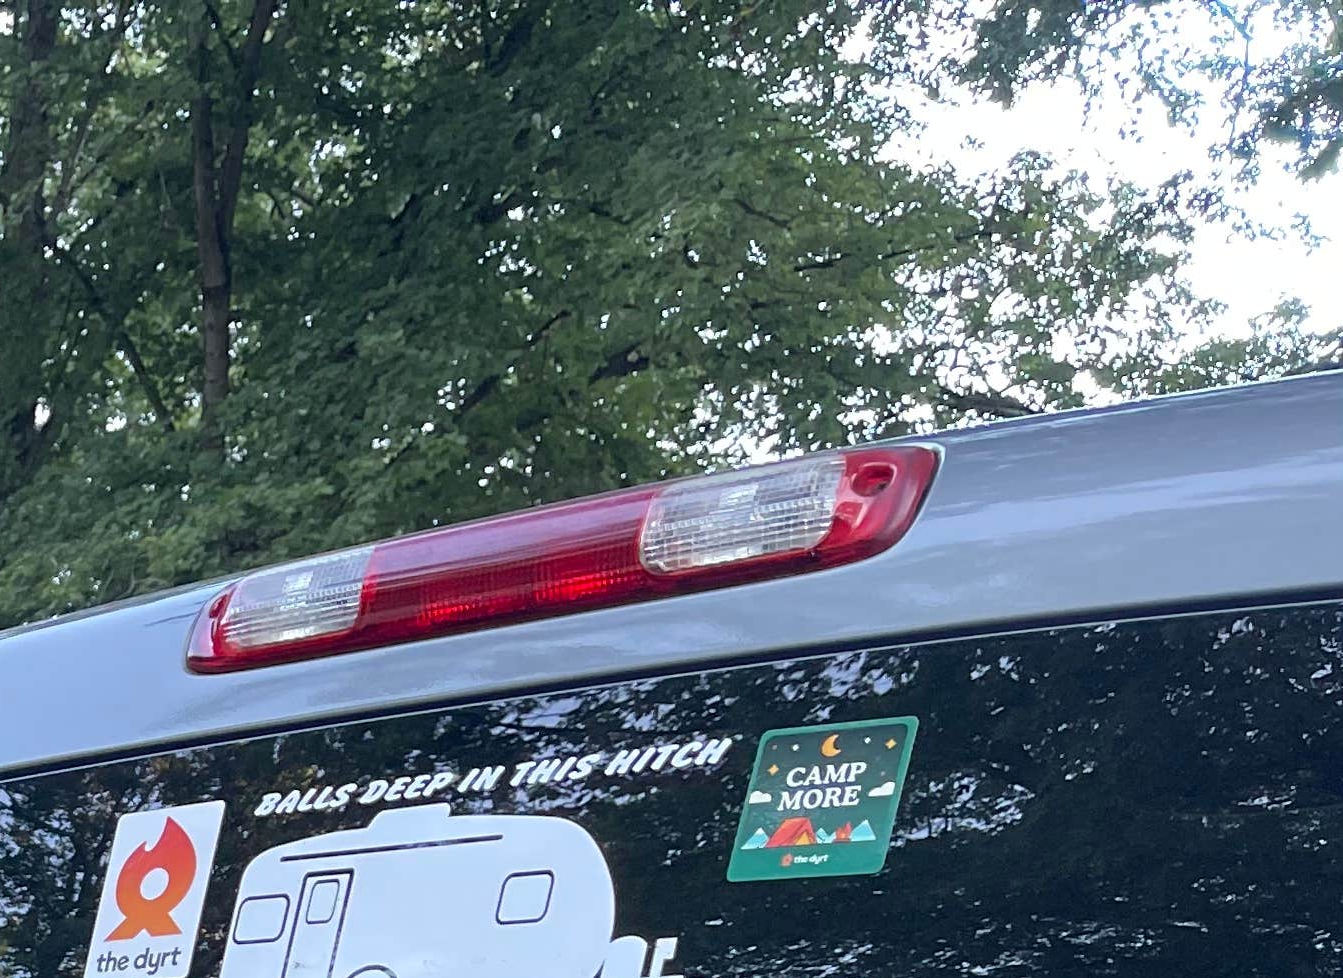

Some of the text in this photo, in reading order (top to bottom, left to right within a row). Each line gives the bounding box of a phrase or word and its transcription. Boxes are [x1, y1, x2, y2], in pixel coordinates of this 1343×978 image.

[254, 738, 732, 816] BALLS DEEP IN THIS HITCH
[786, 761, 867, 787] CAMP
[777, 785, 862, 811] MORE
[793, 855, 808, 864] the
[97, 947, 182, 975] the dyrt
